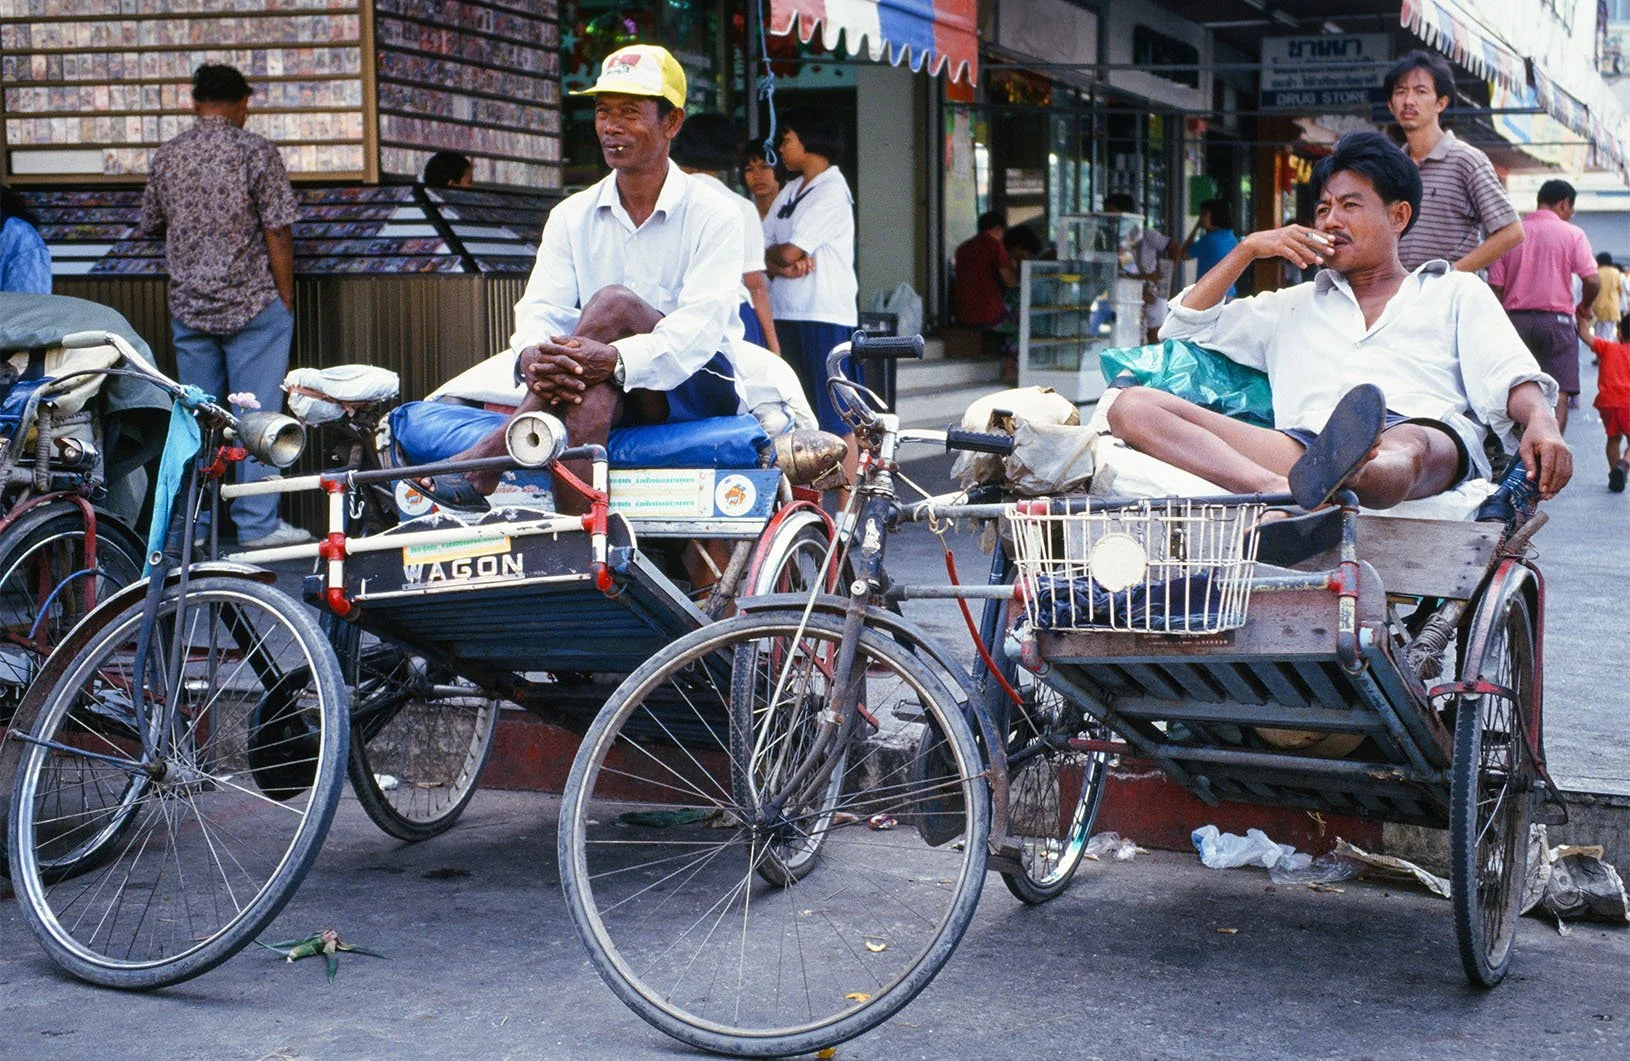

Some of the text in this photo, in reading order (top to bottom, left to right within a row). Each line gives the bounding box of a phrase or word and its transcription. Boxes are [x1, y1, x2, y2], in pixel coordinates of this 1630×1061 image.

[1276, 91, 1368, 106] DRUG STORE
[403, 553, 523, 584] WAGON
